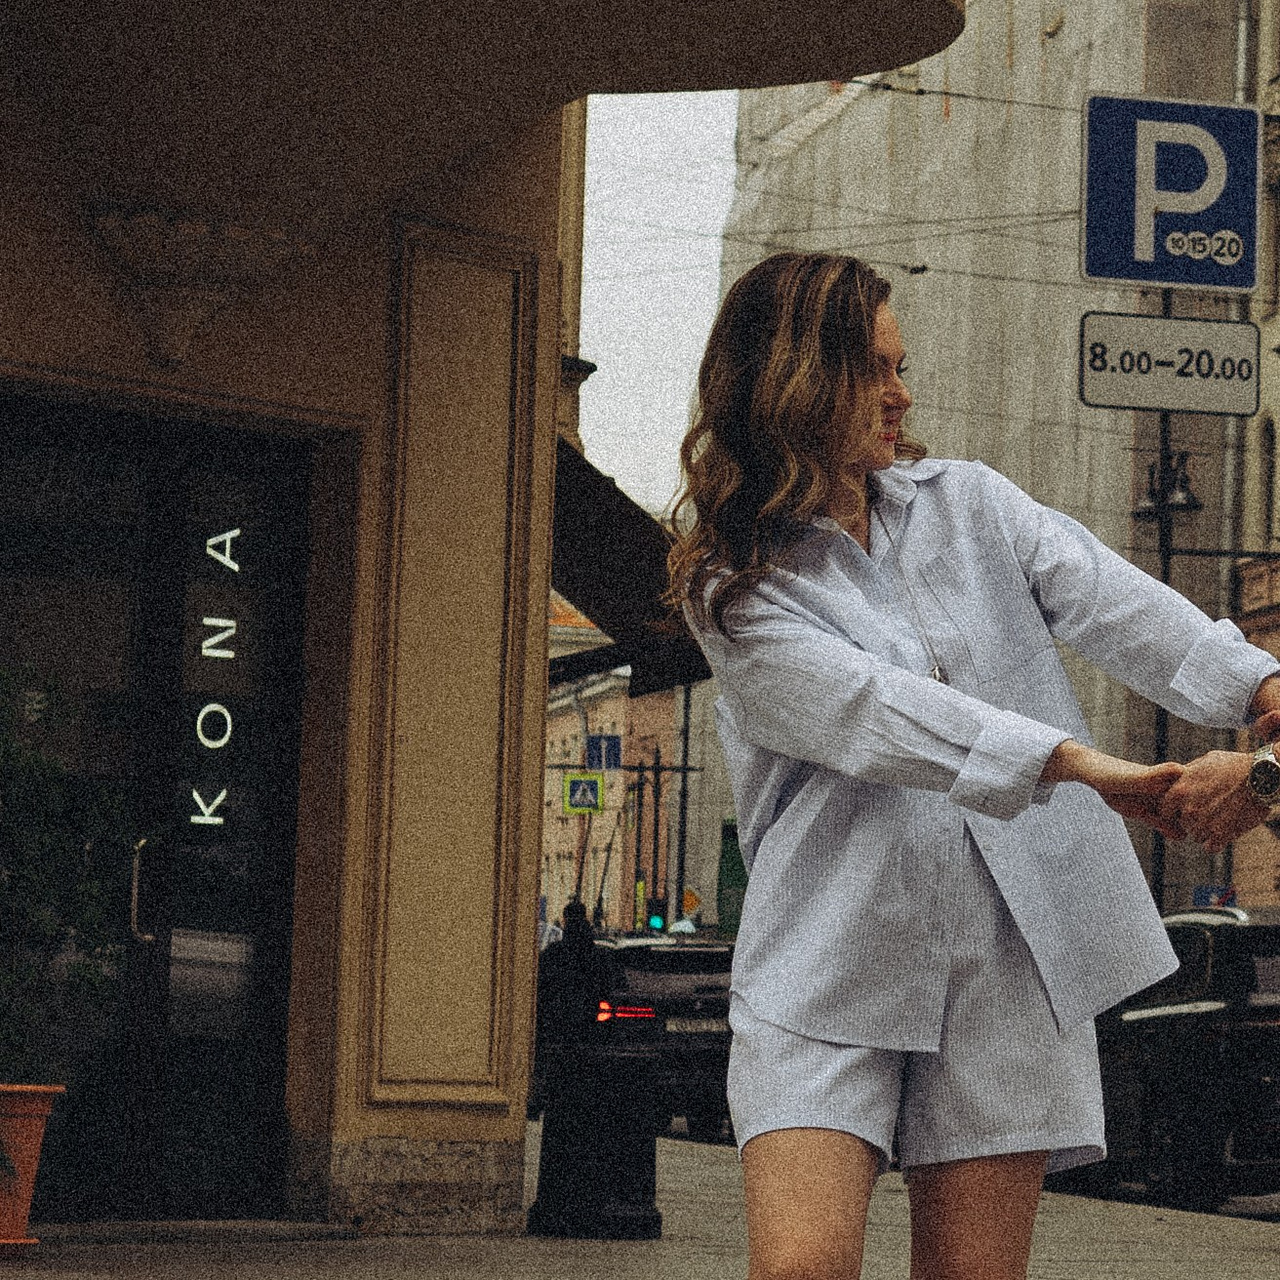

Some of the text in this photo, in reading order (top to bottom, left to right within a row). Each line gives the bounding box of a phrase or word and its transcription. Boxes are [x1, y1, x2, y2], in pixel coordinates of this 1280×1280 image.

[1133, 119, 1229, 263] P
[1189, 236, 1208, 254] 15
[1213, 236, 1241, 258] 20
[190, 527, 241, 826] KONA
